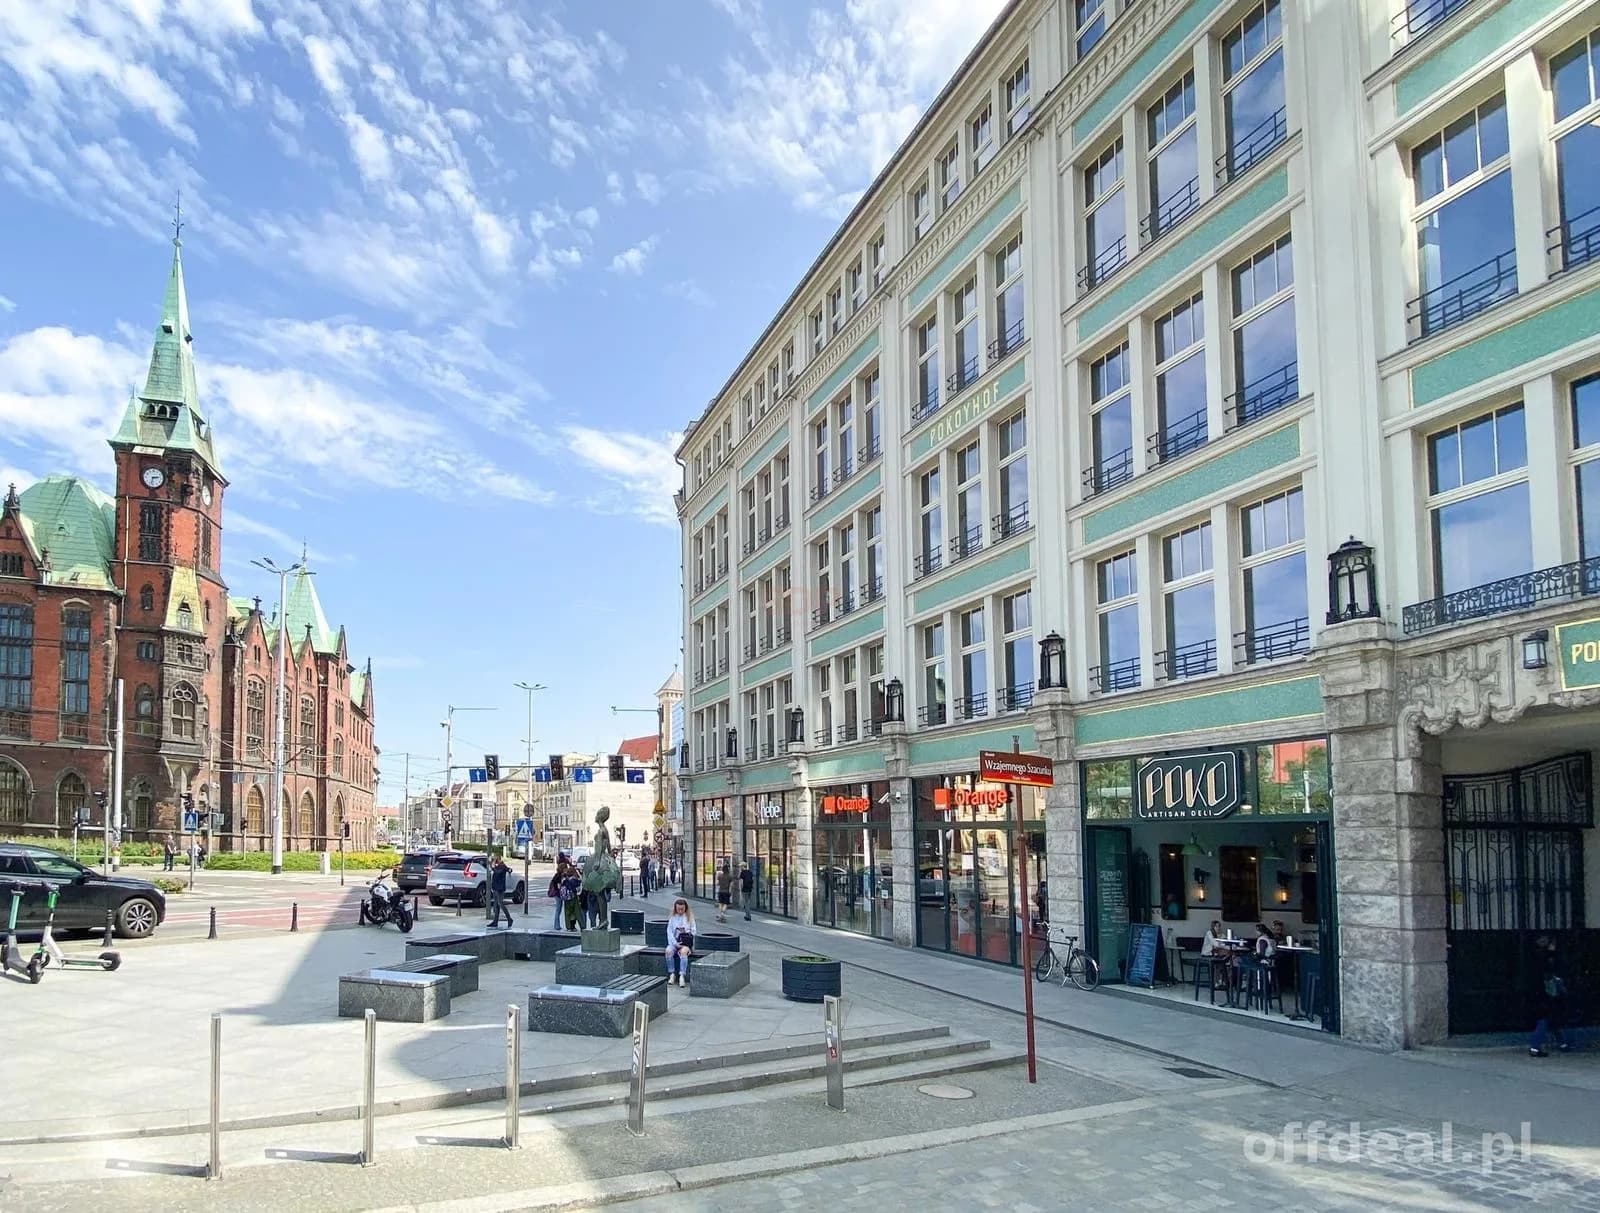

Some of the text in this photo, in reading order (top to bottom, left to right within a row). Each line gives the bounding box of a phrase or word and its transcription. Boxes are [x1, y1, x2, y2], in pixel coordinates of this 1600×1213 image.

[930, 381, 1000, 448] POKOYHOF
[1571, 639, 1600, 665] PO
[984, 759, 1027, 775] Wzajemnego
[1145, 760, 1228, 809] POKO
[836, 796, 870, 813] Orange
[954, 788, 1008, 809] Orange
[760, 800, 780, 818] hebe
[1190, 809, 1212, 817] DELI
